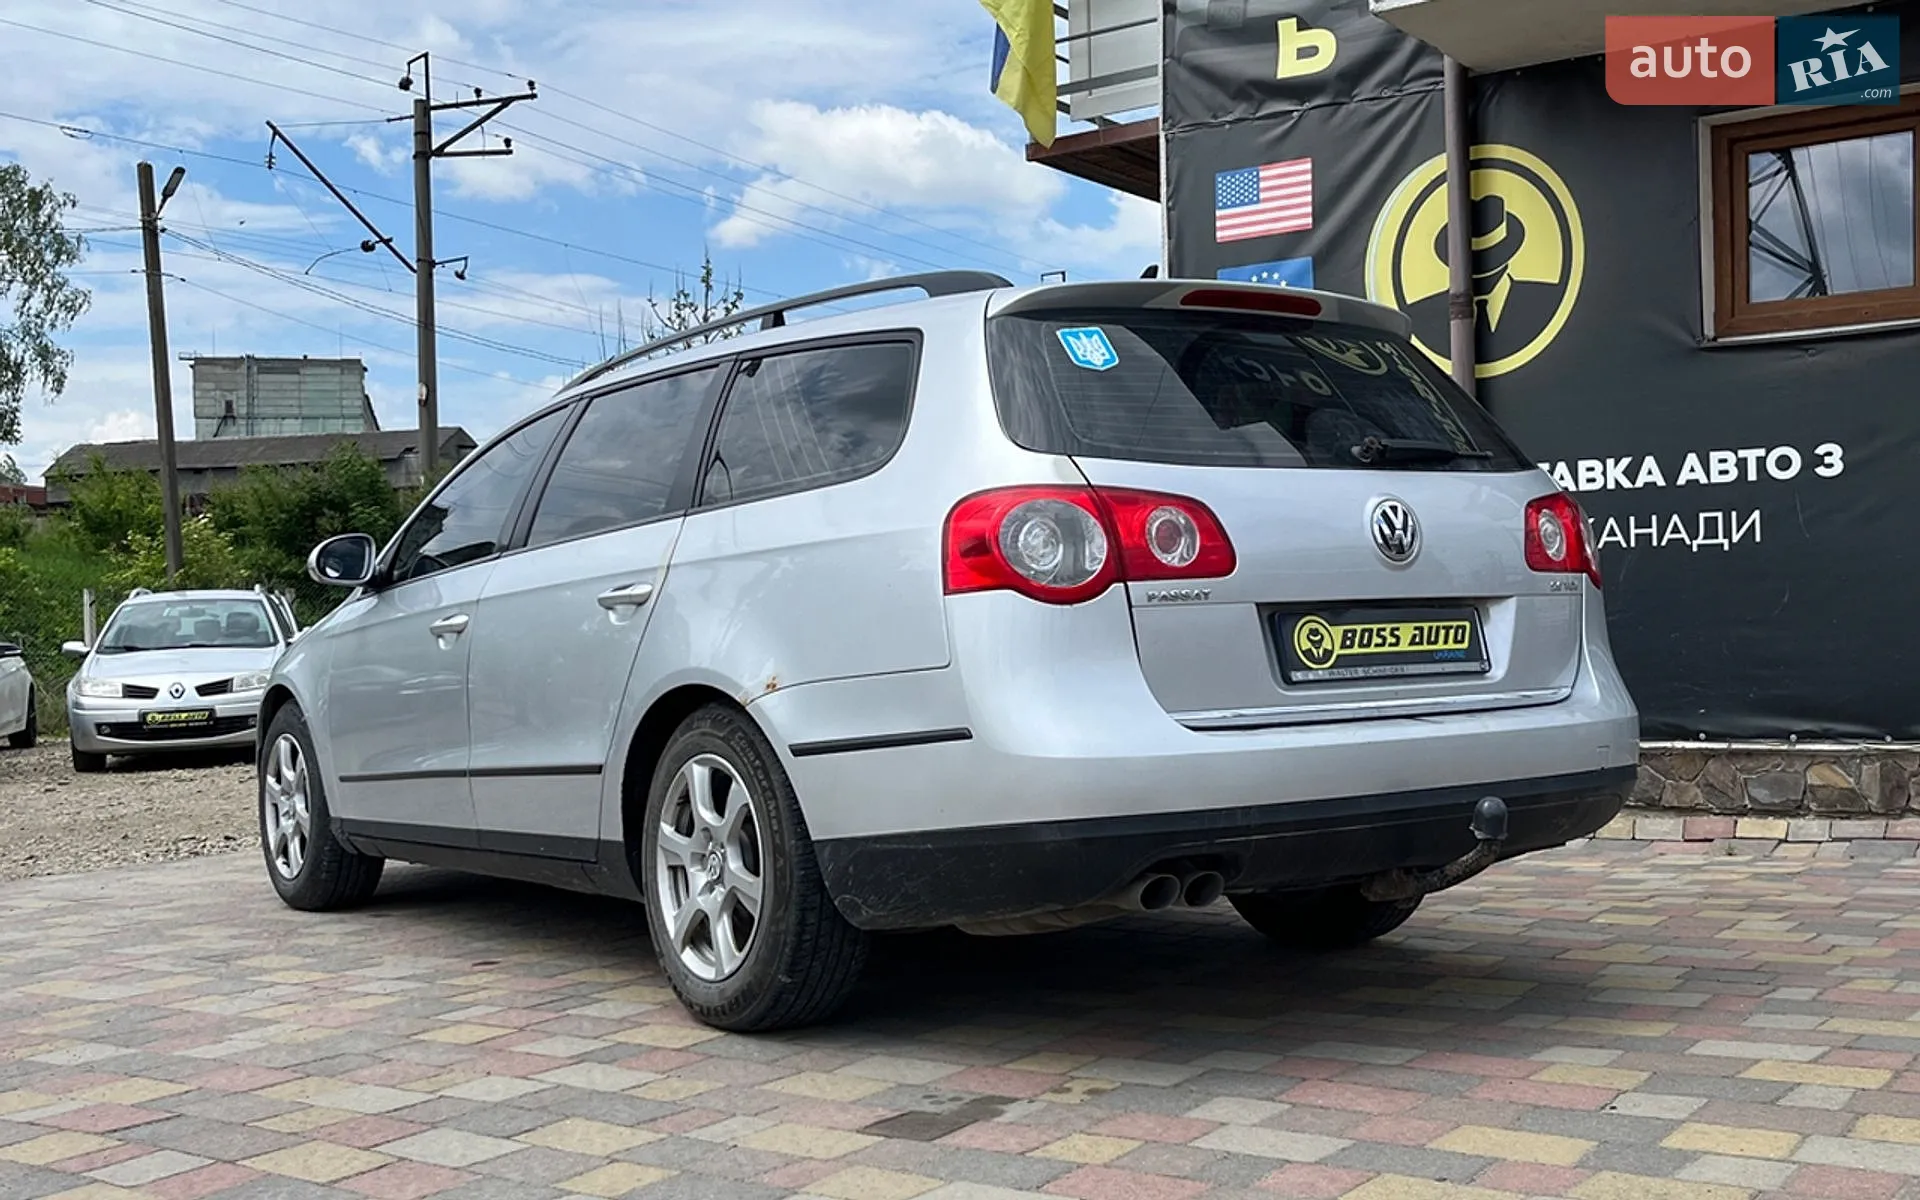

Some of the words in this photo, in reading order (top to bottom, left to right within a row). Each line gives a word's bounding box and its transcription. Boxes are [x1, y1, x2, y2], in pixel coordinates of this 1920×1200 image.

[1676, 445, 1802, 485] АВТО
[1588, 509, 1762, 551] АНАДИ
[1146, 588, 1212, 602] PASSAT
[1340, 627, 1401, 649] BOSS
[1408, 624, 1467, 646] AUTO
